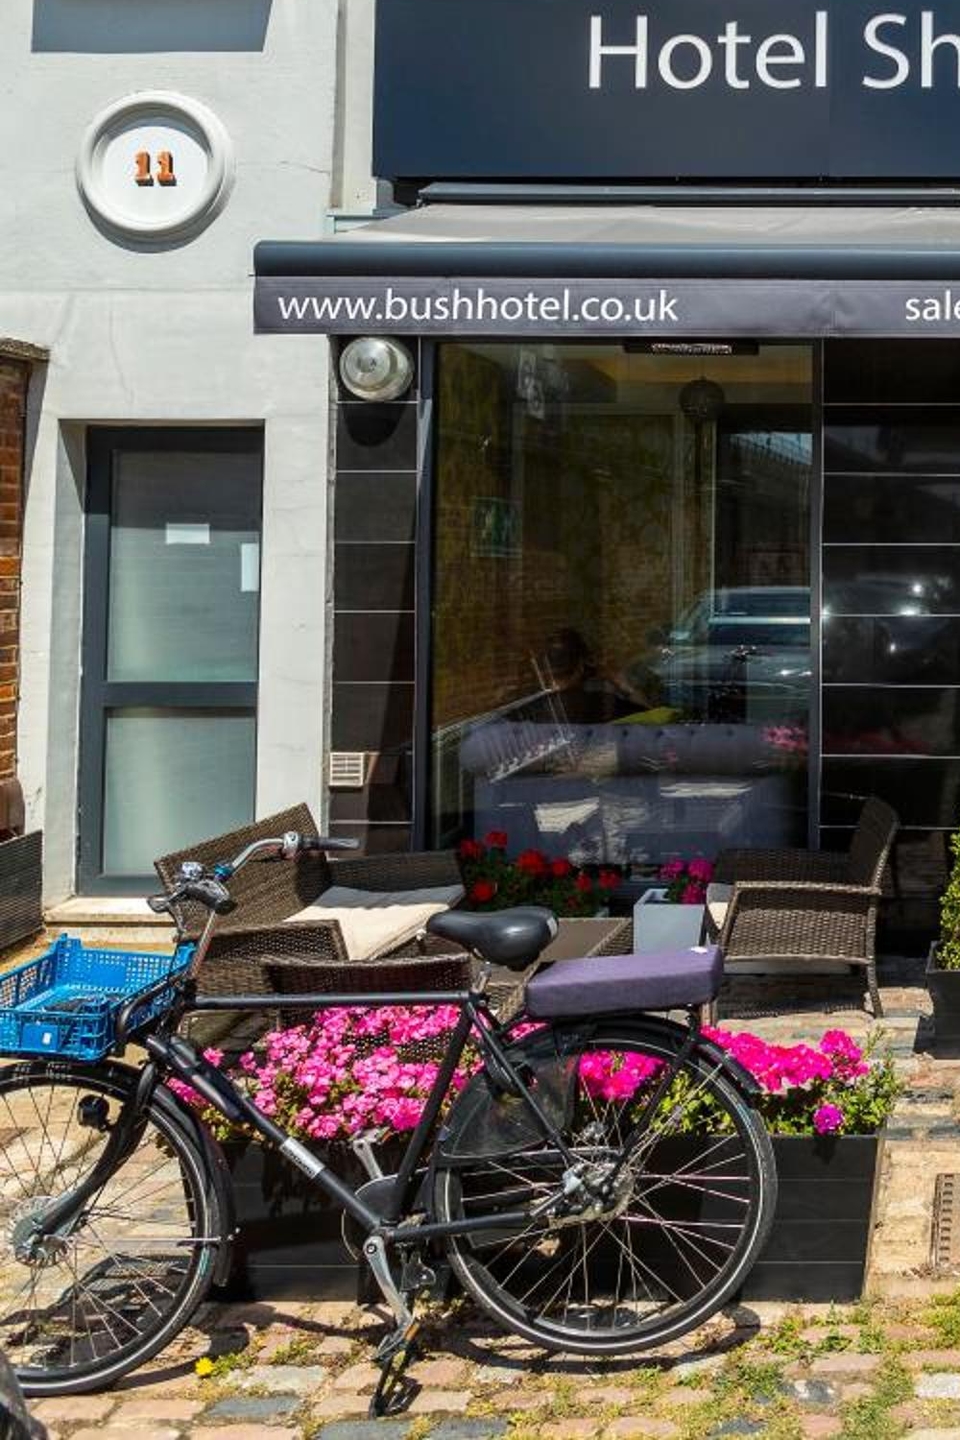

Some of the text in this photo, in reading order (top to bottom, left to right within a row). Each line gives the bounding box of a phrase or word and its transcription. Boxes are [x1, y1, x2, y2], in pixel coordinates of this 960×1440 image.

[588, 11, 828, 90] Hotel
[134, 148, 177, 187] 11
[278, 287, 679, 322] www.bushhotel.co.uk
